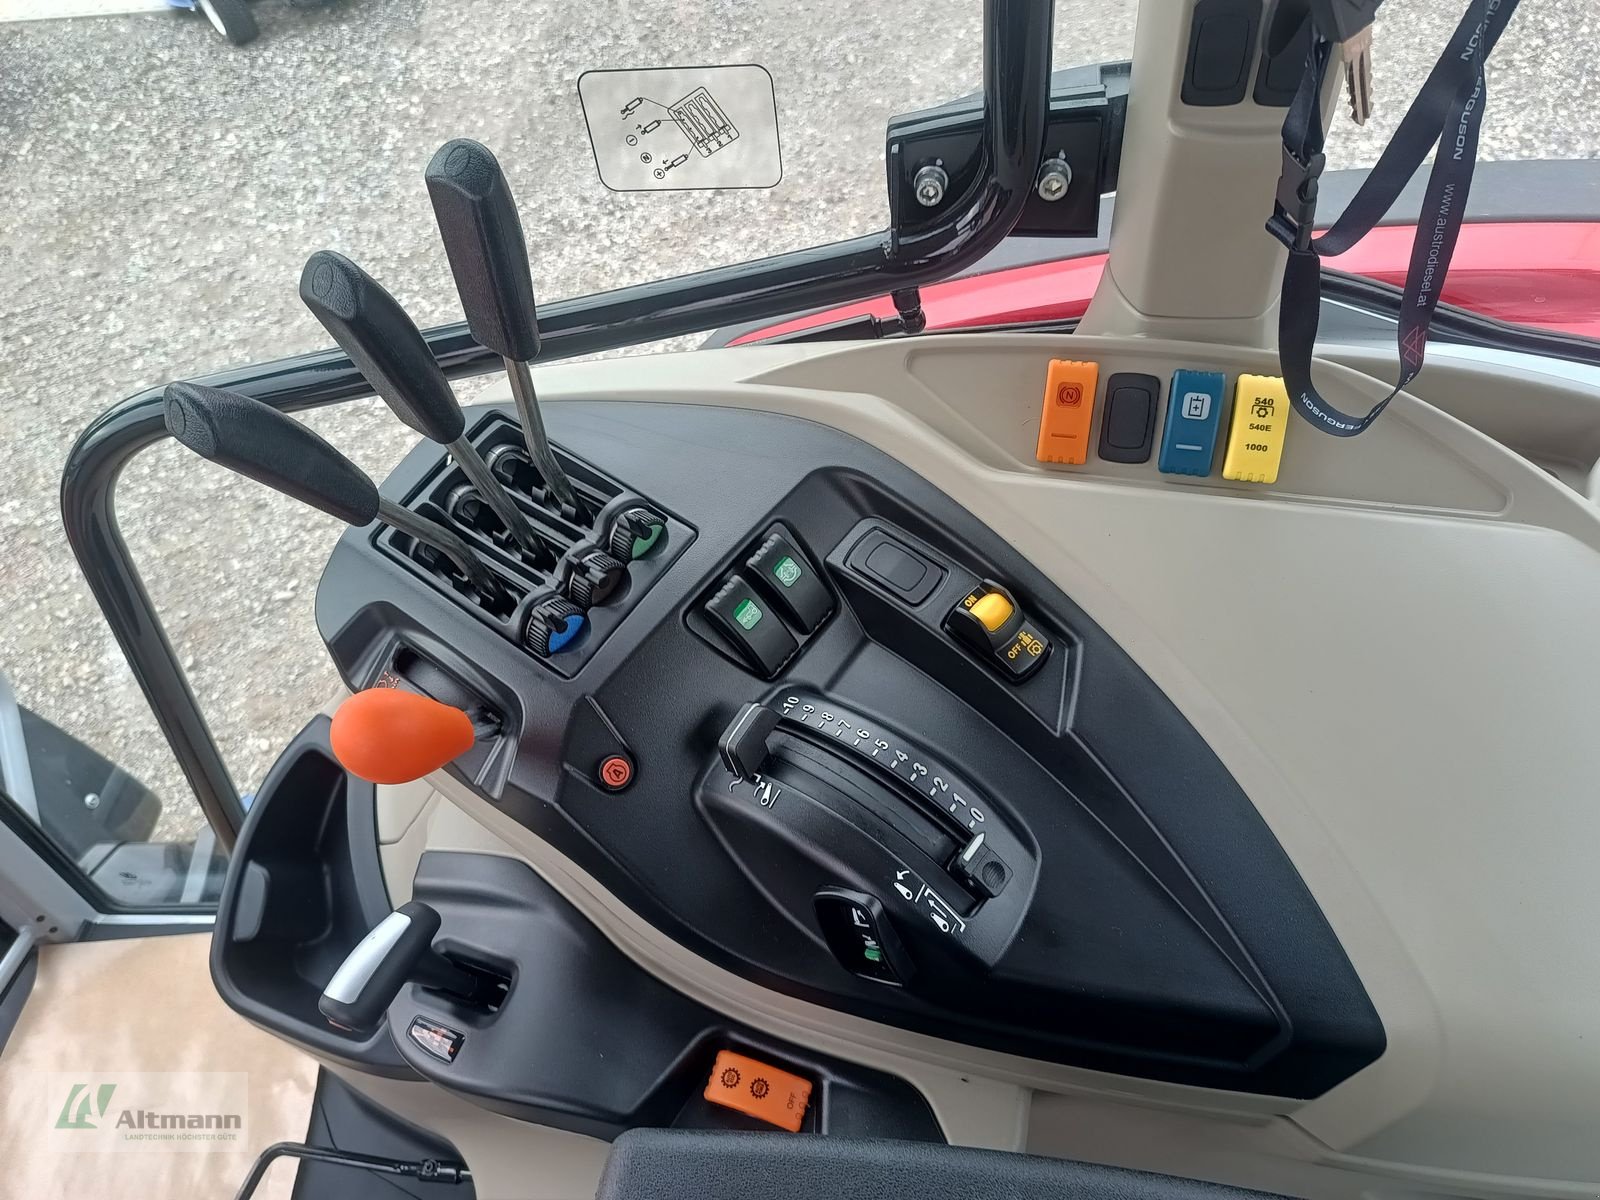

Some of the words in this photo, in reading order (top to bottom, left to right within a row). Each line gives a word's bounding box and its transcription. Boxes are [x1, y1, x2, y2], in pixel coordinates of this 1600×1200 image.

[1416, 183, 1456, 307] www.austrodiesel.at
[1065, 391, 1074, 400] N
[1254, 397, 1274, 406] 540
[1248, 423, 1272, 432] 540E
[1245, 443, 1268, 452] 1000
[964, 594, 978, 607] ON
[1007, 643, 1022, 659] OFF
[783, 696, 799, 708] 10
[802, 704, 815, 713] 9
[821, 711, 834, 721] 8
[837, 719, 851, 729] 7
[856, 728, 870, 739] 6
[874, 738, 889, 750] 5
[895, 749, 909, 762] 4
[613, 768, 623, 779] A
[912, 762, 928, 776] 3
[933, 776, 949, 792] 2
[953, 792, 967, 806] 1
[970, 807, 985, 822] 0
[786, 1092, 796, 1110] OFF
